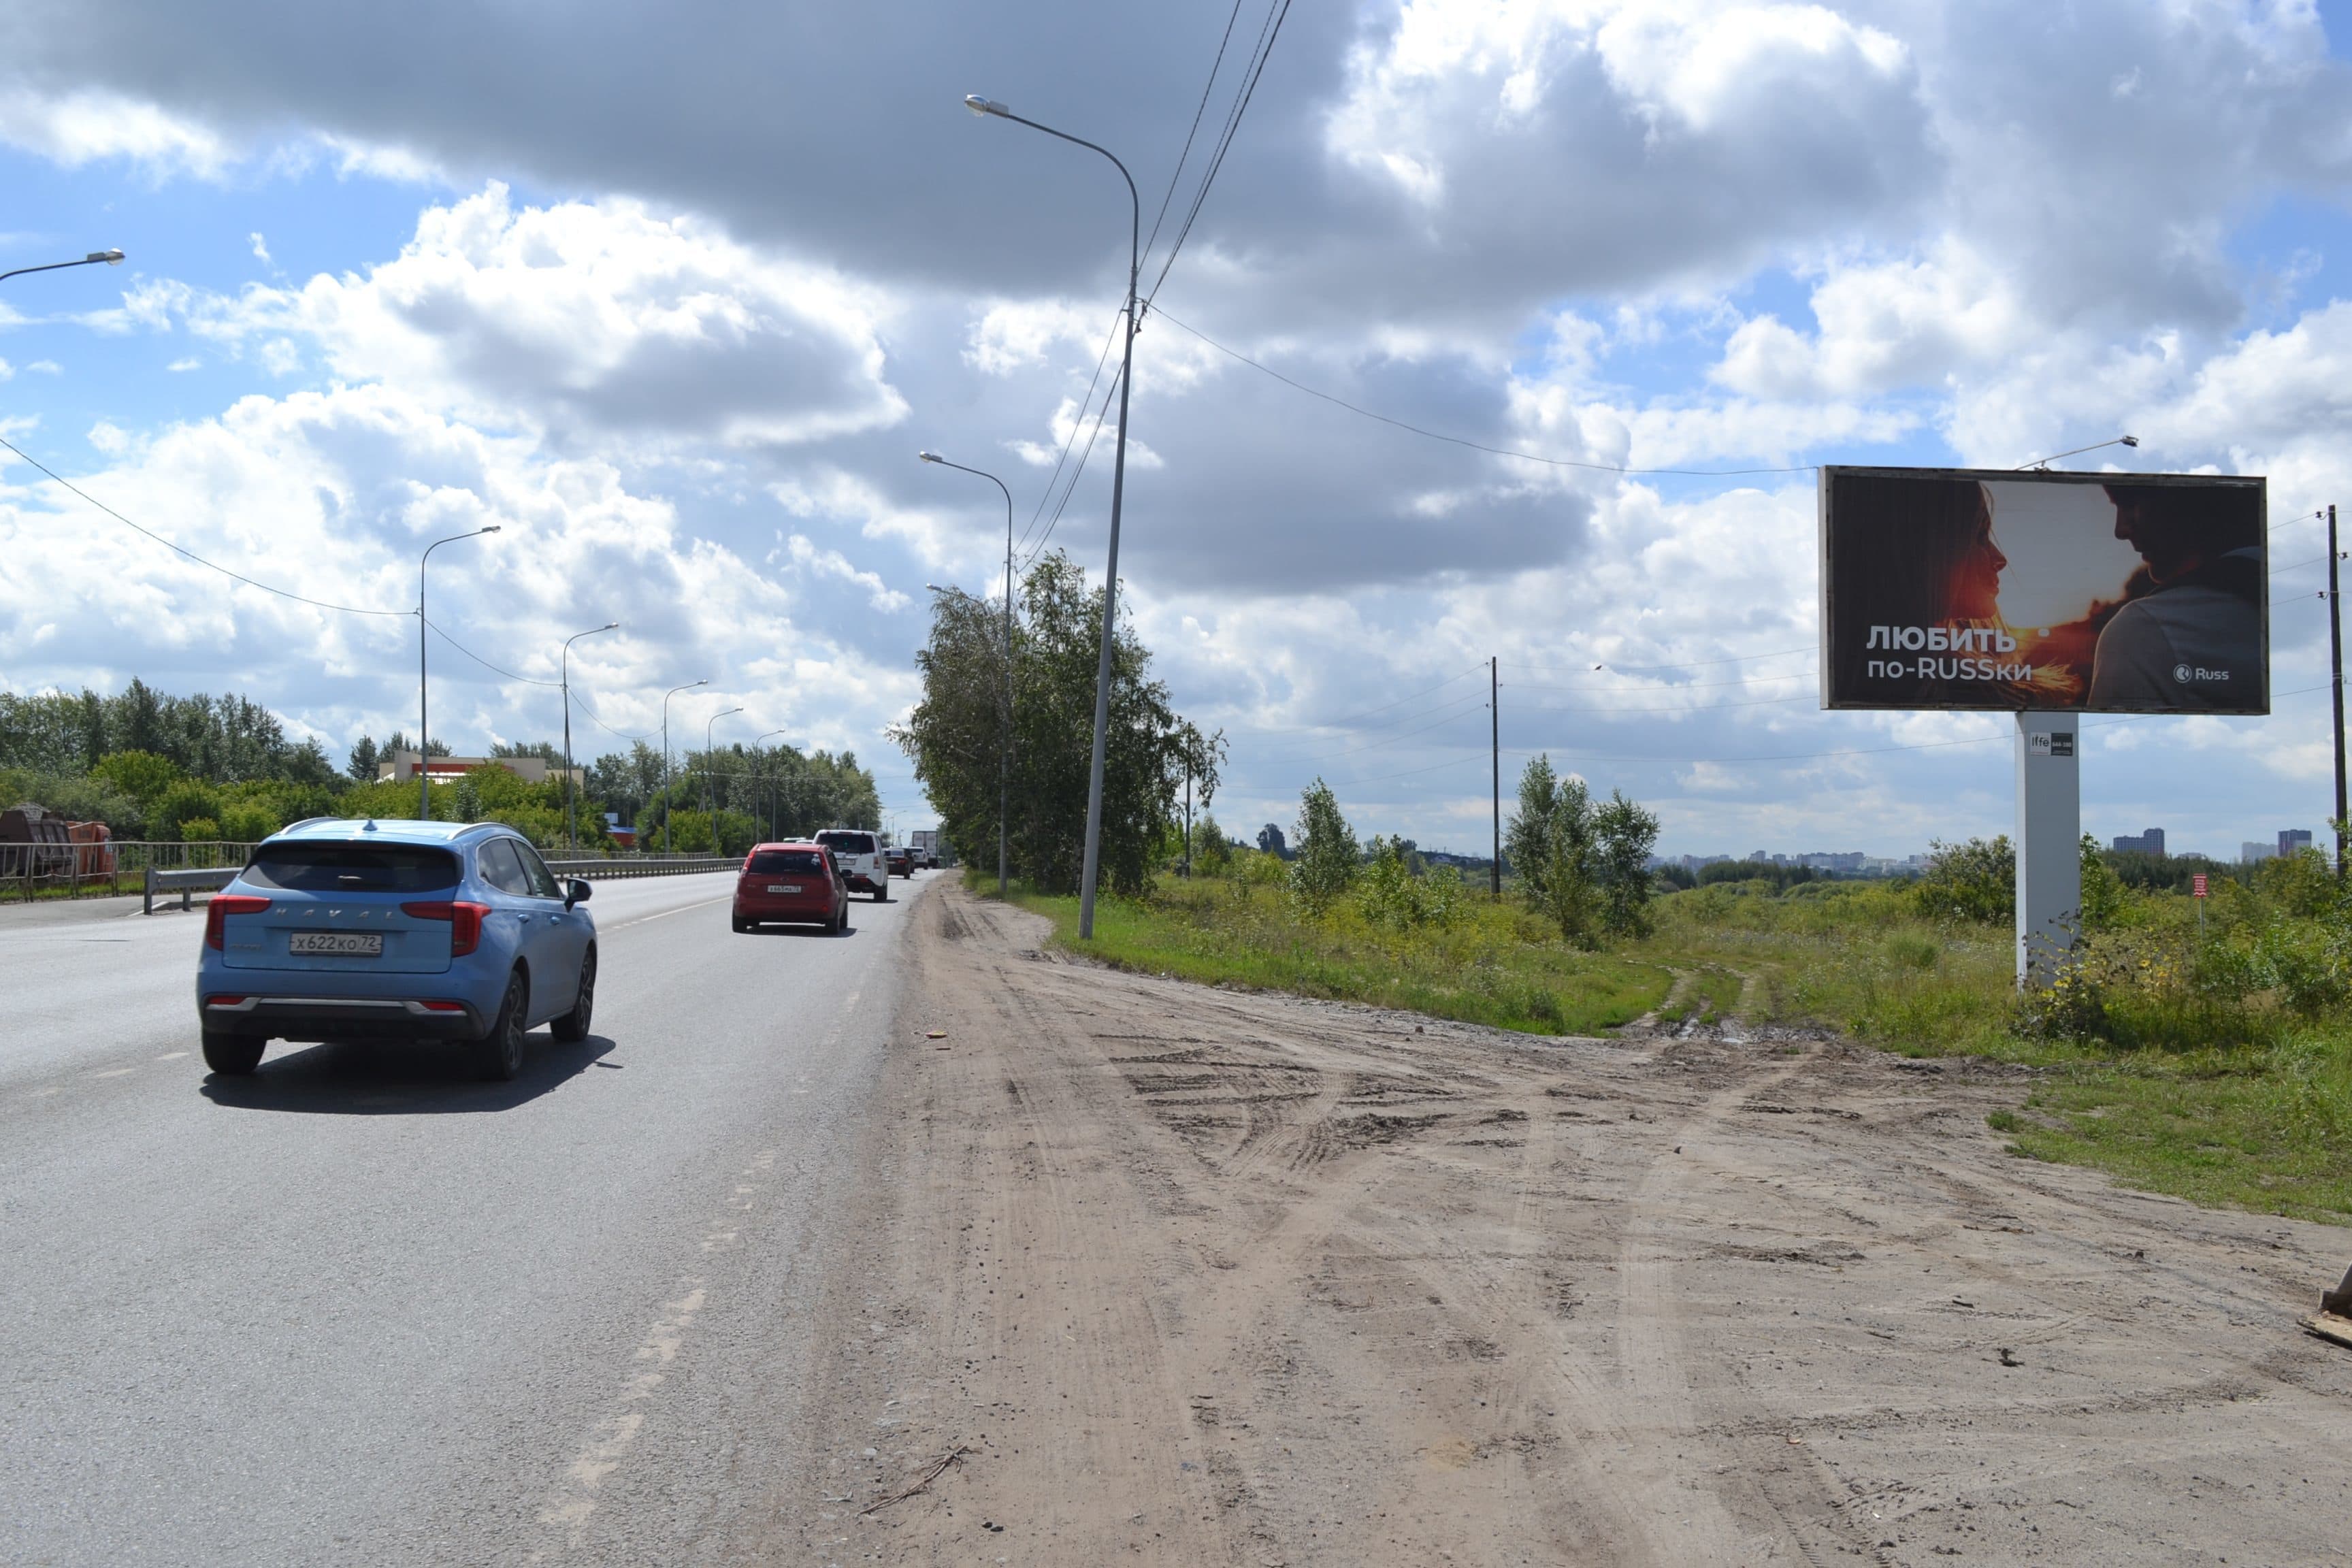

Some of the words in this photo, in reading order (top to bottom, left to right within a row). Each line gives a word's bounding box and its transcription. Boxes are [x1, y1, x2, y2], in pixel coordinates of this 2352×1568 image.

[1866, 625, 2016, 652] ЛЮБИТЬ
[1868, 657, 2031, 681] по-RUSSки
[2195, 668, 2230, 680] Russ
[276, 908, 392, 919] HAVAL
